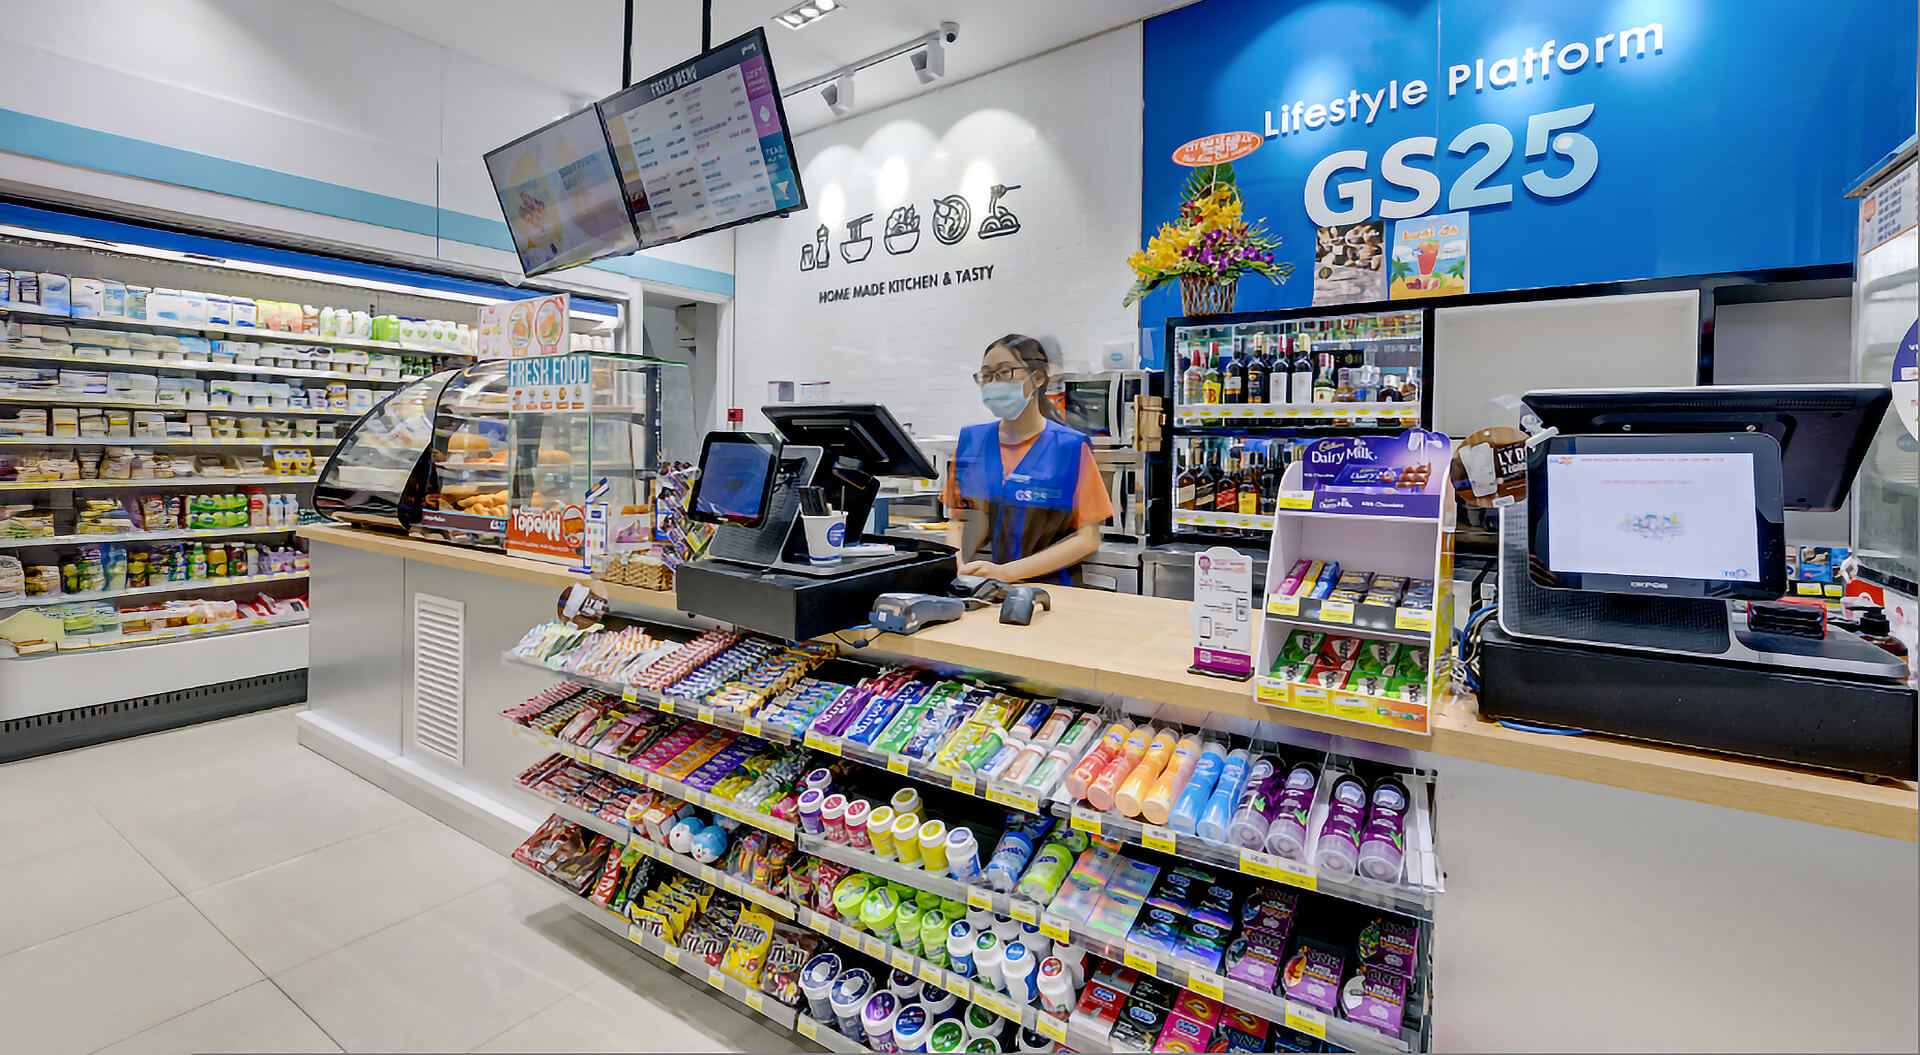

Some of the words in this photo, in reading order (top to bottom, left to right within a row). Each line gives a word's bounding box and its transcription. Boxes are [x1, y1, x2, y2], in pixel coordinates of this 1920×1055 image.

[1263, 76, 1428, 138] Lifestyle
[1448, 22, 1664, 97] Platform
[1303, 103, 1600, 228] GS25
[819, 289, 850, 304] HOME
[852, 282, 885, 299] MADE
[888, 273, 938, 294] KITCHEN
[942, 271, 952, 286] &
[955, 265, 994, 284] TASTY
[510, 358, 549, 387] FRESH
[552, 356, 587, 385] FOOD
[1311, 450, 1345, 464] Dairy
[1346, 445, 1374, 461] Milk
[1308, 948, 1340, 969] ONE
[1367, 968, 1402, 989] ONE
[1232, 1031, 1261, 1050] ONE
